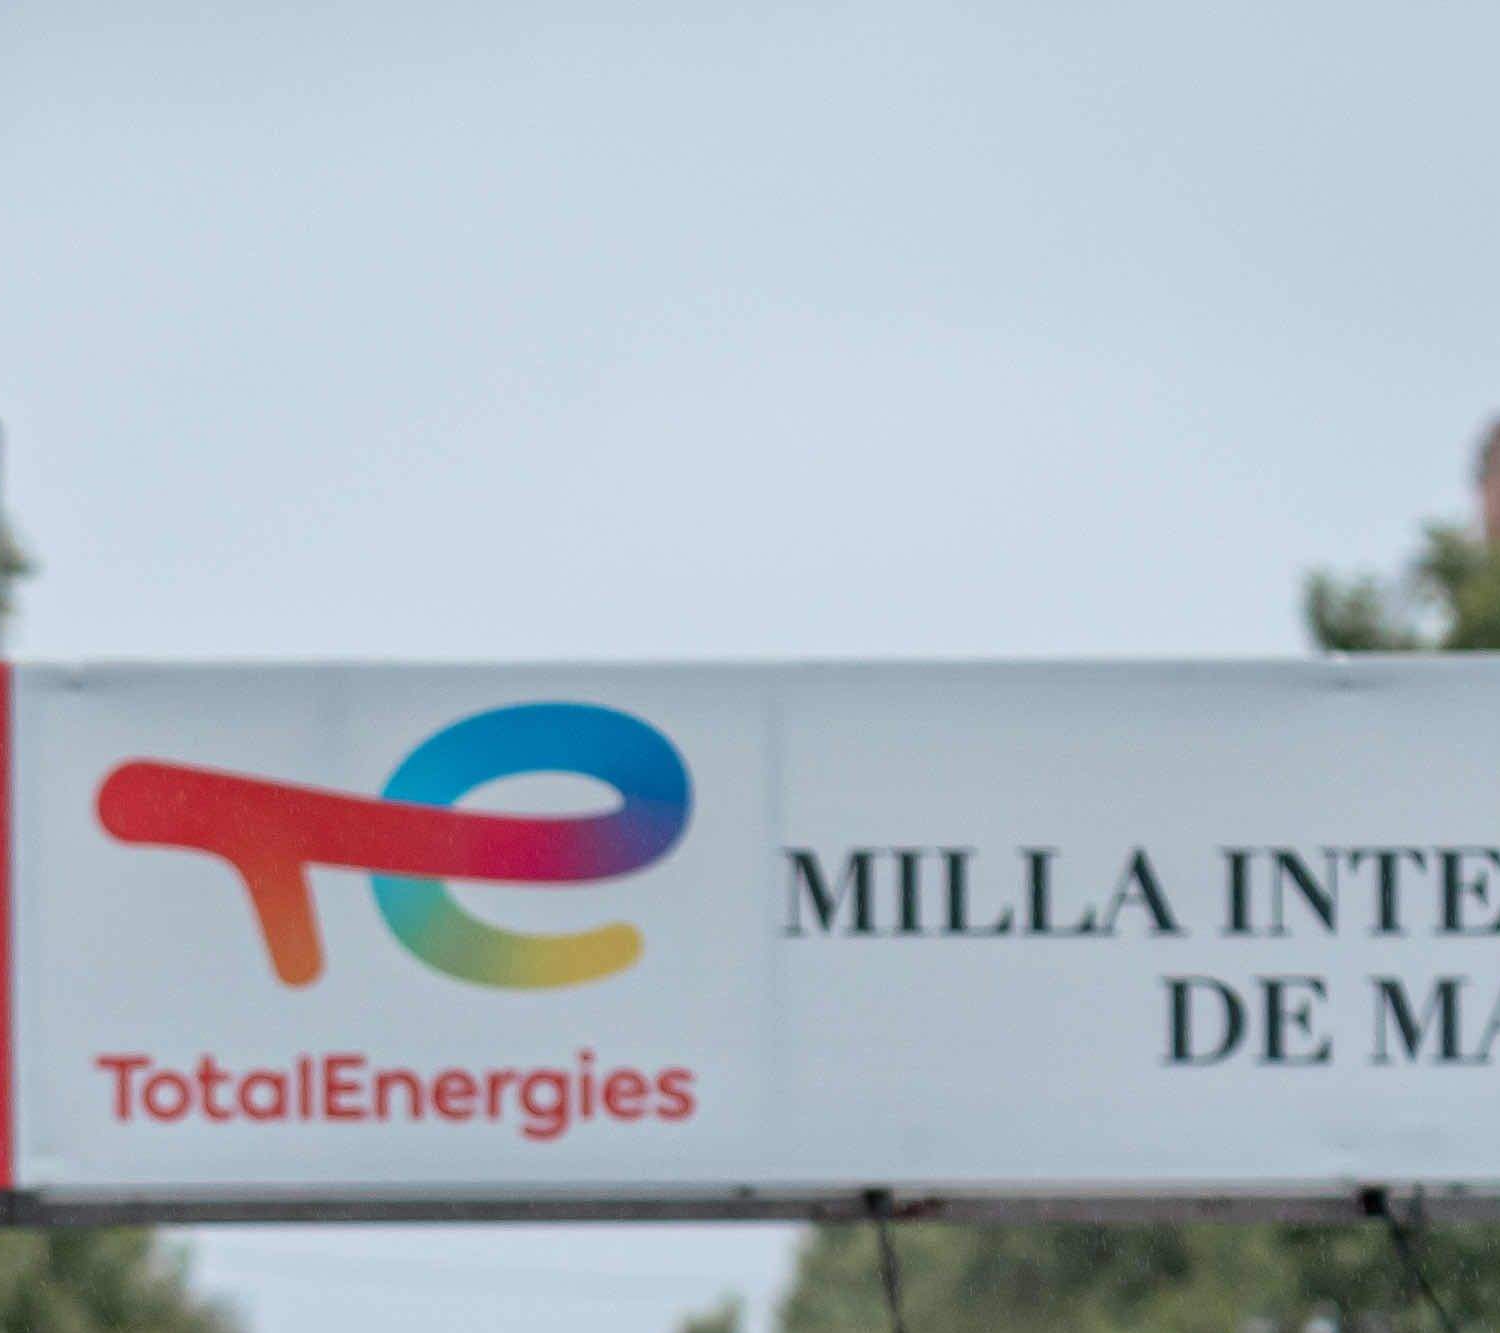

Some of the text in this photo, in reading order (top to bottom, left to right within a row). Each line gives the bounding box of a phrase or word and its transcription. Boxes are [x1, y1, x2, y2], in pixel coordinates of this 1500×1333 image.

[788, 848, 1182, 937] MILLA
[1162, 976, 1332, 1066] DE
[96, 1050, 696, 1142] TotalEnergies
